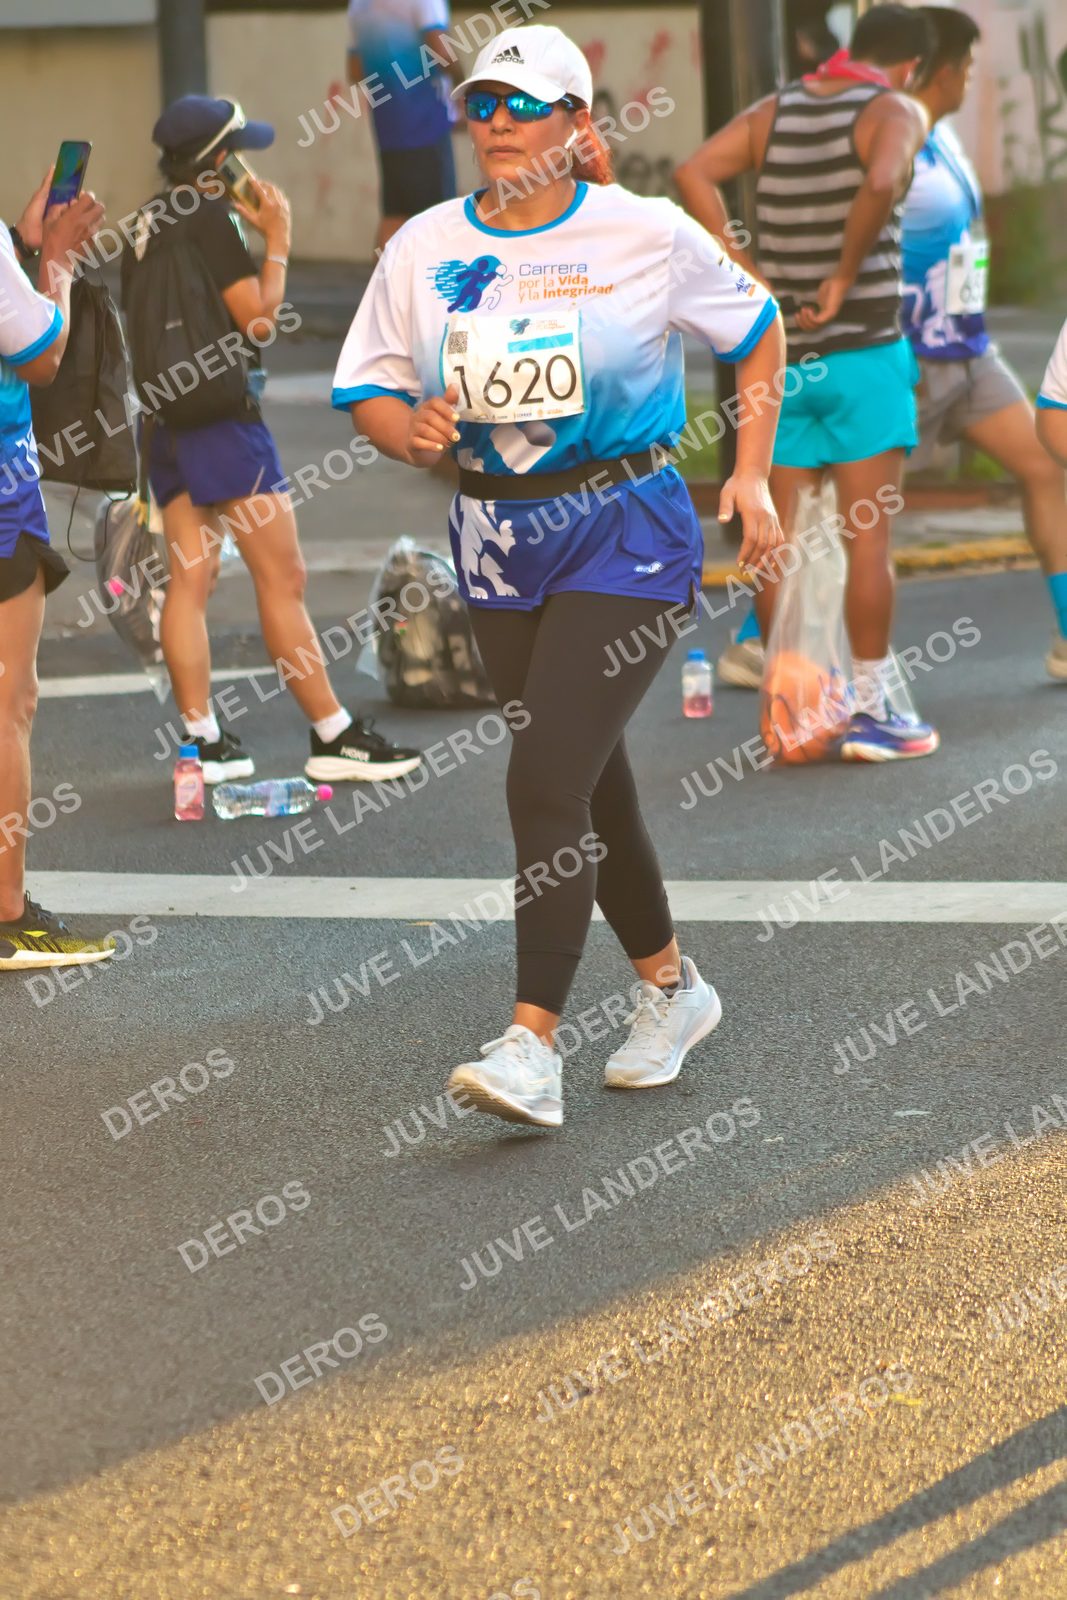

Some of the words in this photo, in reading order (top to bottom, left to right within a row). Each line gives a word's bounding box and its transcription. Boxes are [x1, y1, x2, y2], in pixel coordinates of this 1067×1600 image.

[491, 55, 524, 64] adidas
[519, 263, 587, 276] Carrera
[519, 279, 540, 290] por
[543, 276, 554, 288] la
[558, 273, 588, 286] Vida
[519, 293, 525, 303] y
[529, 289, 539, 300] la
[543, 284, 613, 299] Integridad
[453, 354, 577, 409] 1620
